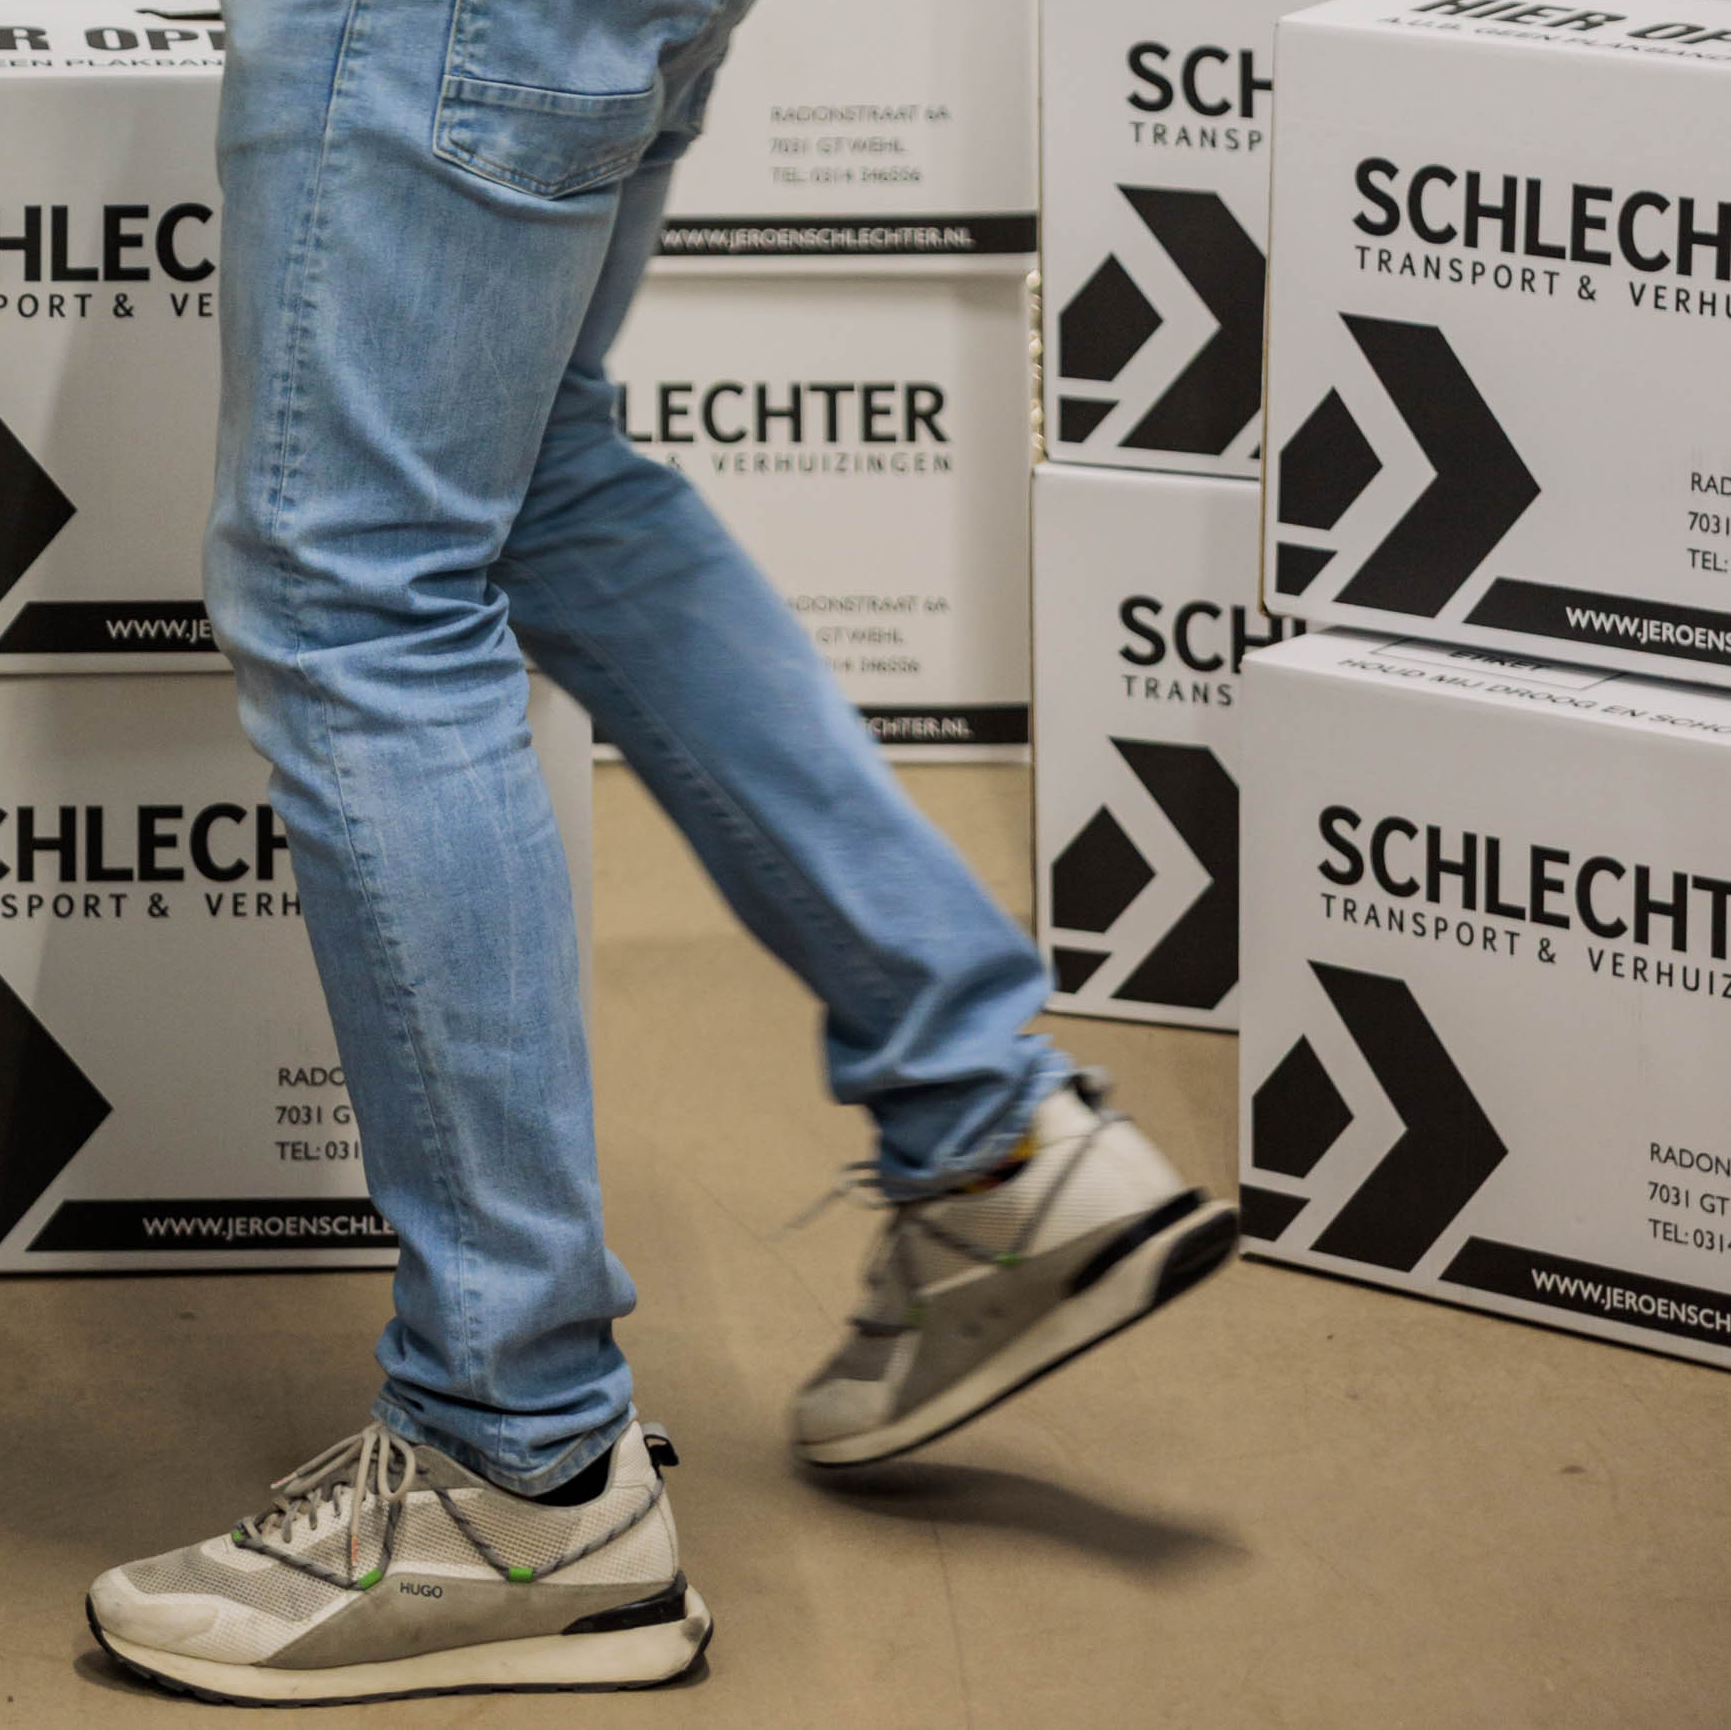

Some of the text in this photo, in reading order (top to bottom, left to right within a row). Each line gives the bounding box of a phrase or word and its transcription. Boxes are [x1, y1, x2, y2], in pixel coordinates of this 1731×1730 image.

[1354, 243, 1561, 297] TRANSPORT
[1577, 274, 1597, 303] &
[112, 293, 136, 319] &
[711, 451, 955, 475] VERHUIZINGEN
[1687, 510, 1730, 537] 7031
[1338, 658, 1427, 678] HOUD
[1486, 683, 1598, 710] DROOG
[1601, 703, 1648, 718] EN
[148, 893, 170, 919] &
[1320, 892, 1522, 958] TRANSPORT
[1537, 937, 1557, 966] &
[275, 1105, 322, 1125] 7031
[1648, 1180, 1730, 1217] 7031 GT
[400, 1581, 443, 1599] HUGO
